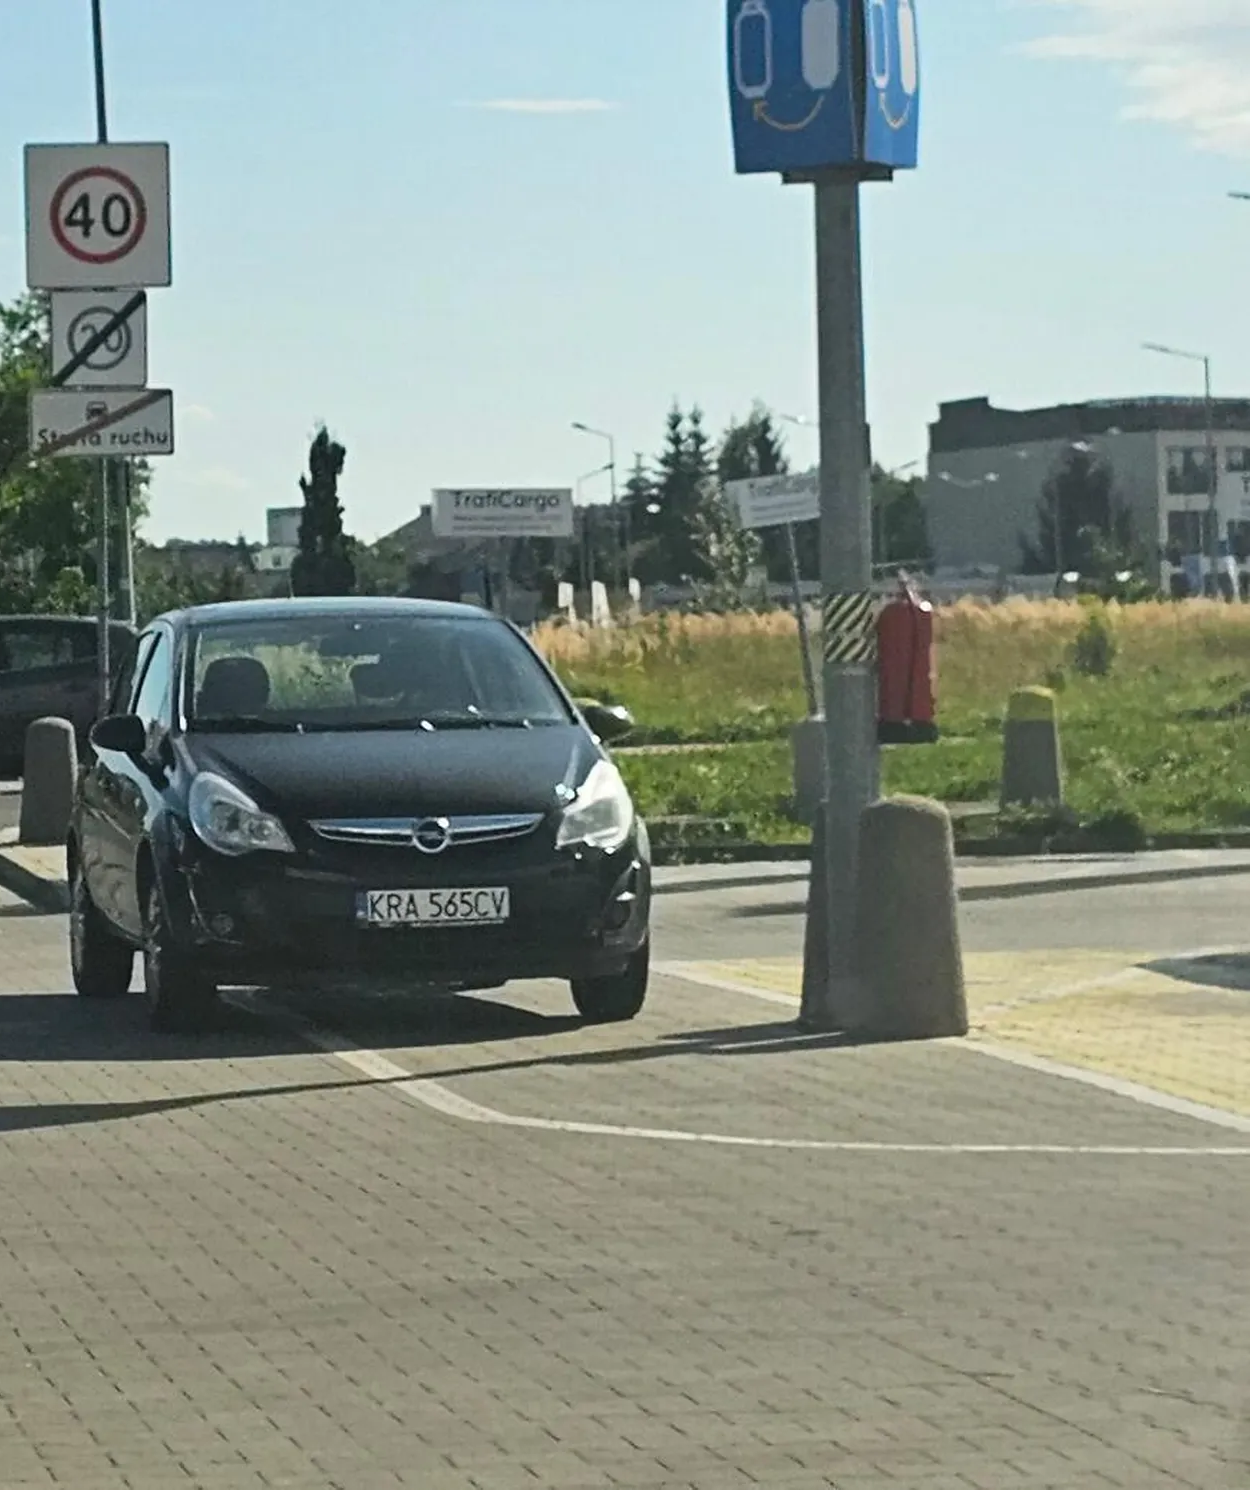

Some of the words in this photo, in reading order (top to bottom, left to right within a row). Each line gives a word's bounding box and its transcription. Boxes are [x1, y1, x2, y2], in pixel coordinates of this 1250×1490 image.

[64, 193, 131, 239] 40
[110, 427, 169, 445] ruchu
[451, 490, 560, 512] TrafiCargo
[369, 892, 419, 919] KRA
[429, 890, 505, 917] 565CV
